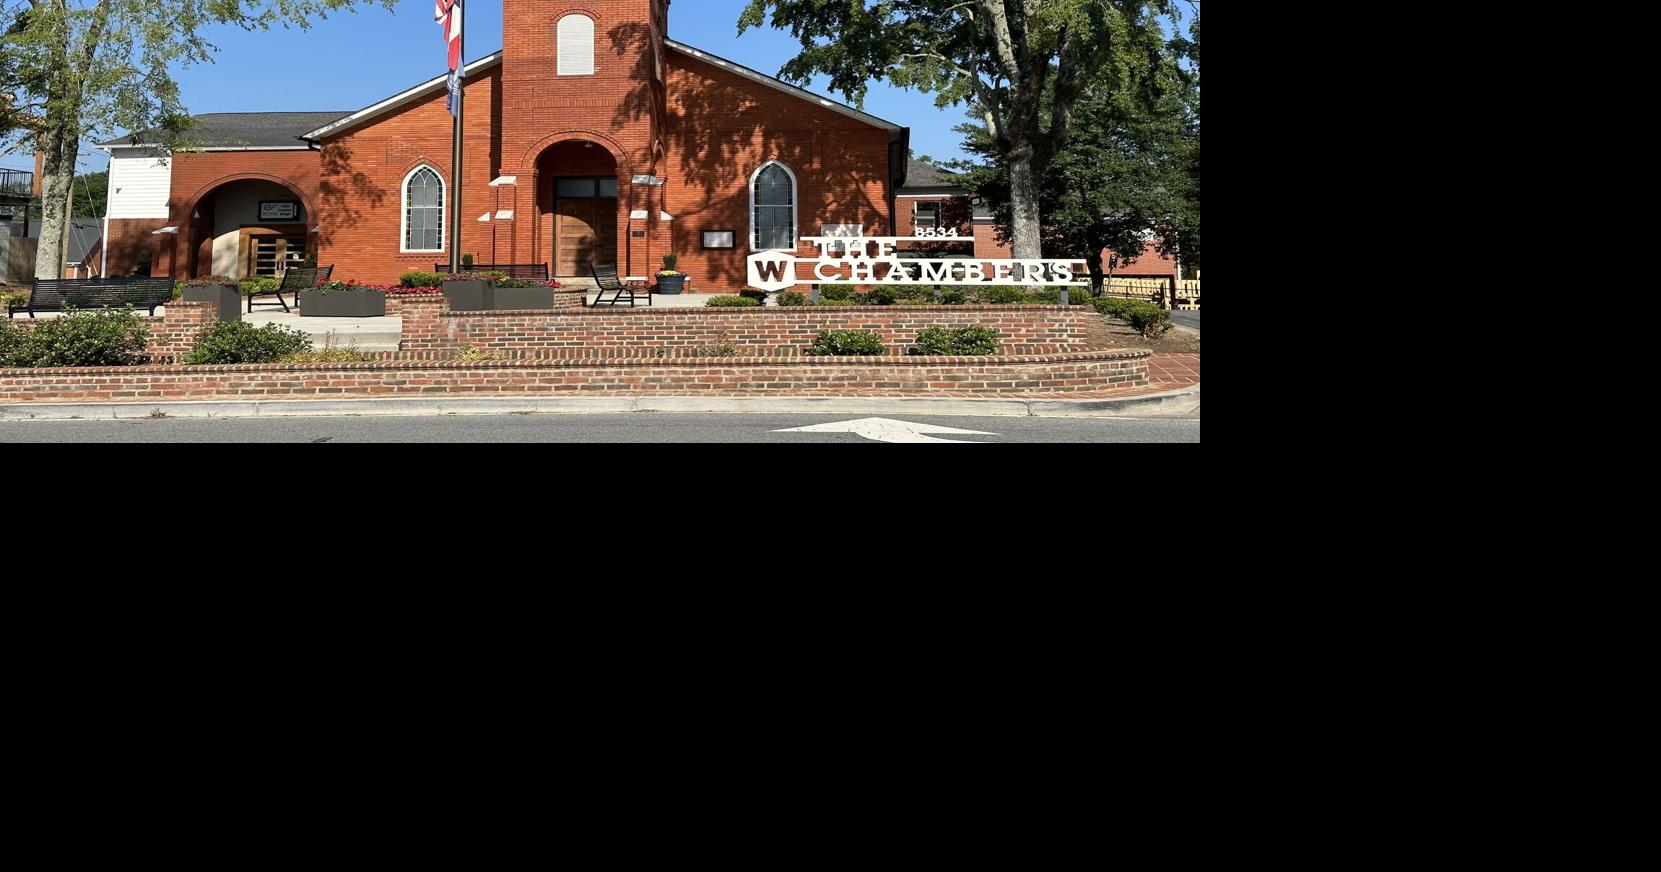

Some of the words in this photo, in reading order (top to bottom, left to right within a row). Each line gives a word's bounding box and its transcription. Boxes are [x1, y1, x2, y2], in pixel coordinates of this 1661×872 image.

[914, 227, 958, 238] 8534
[814, 237, 897, 260] THE
[755, 260, 787, 282] W
[813, 259, 1074, 283] CHAMBERS
